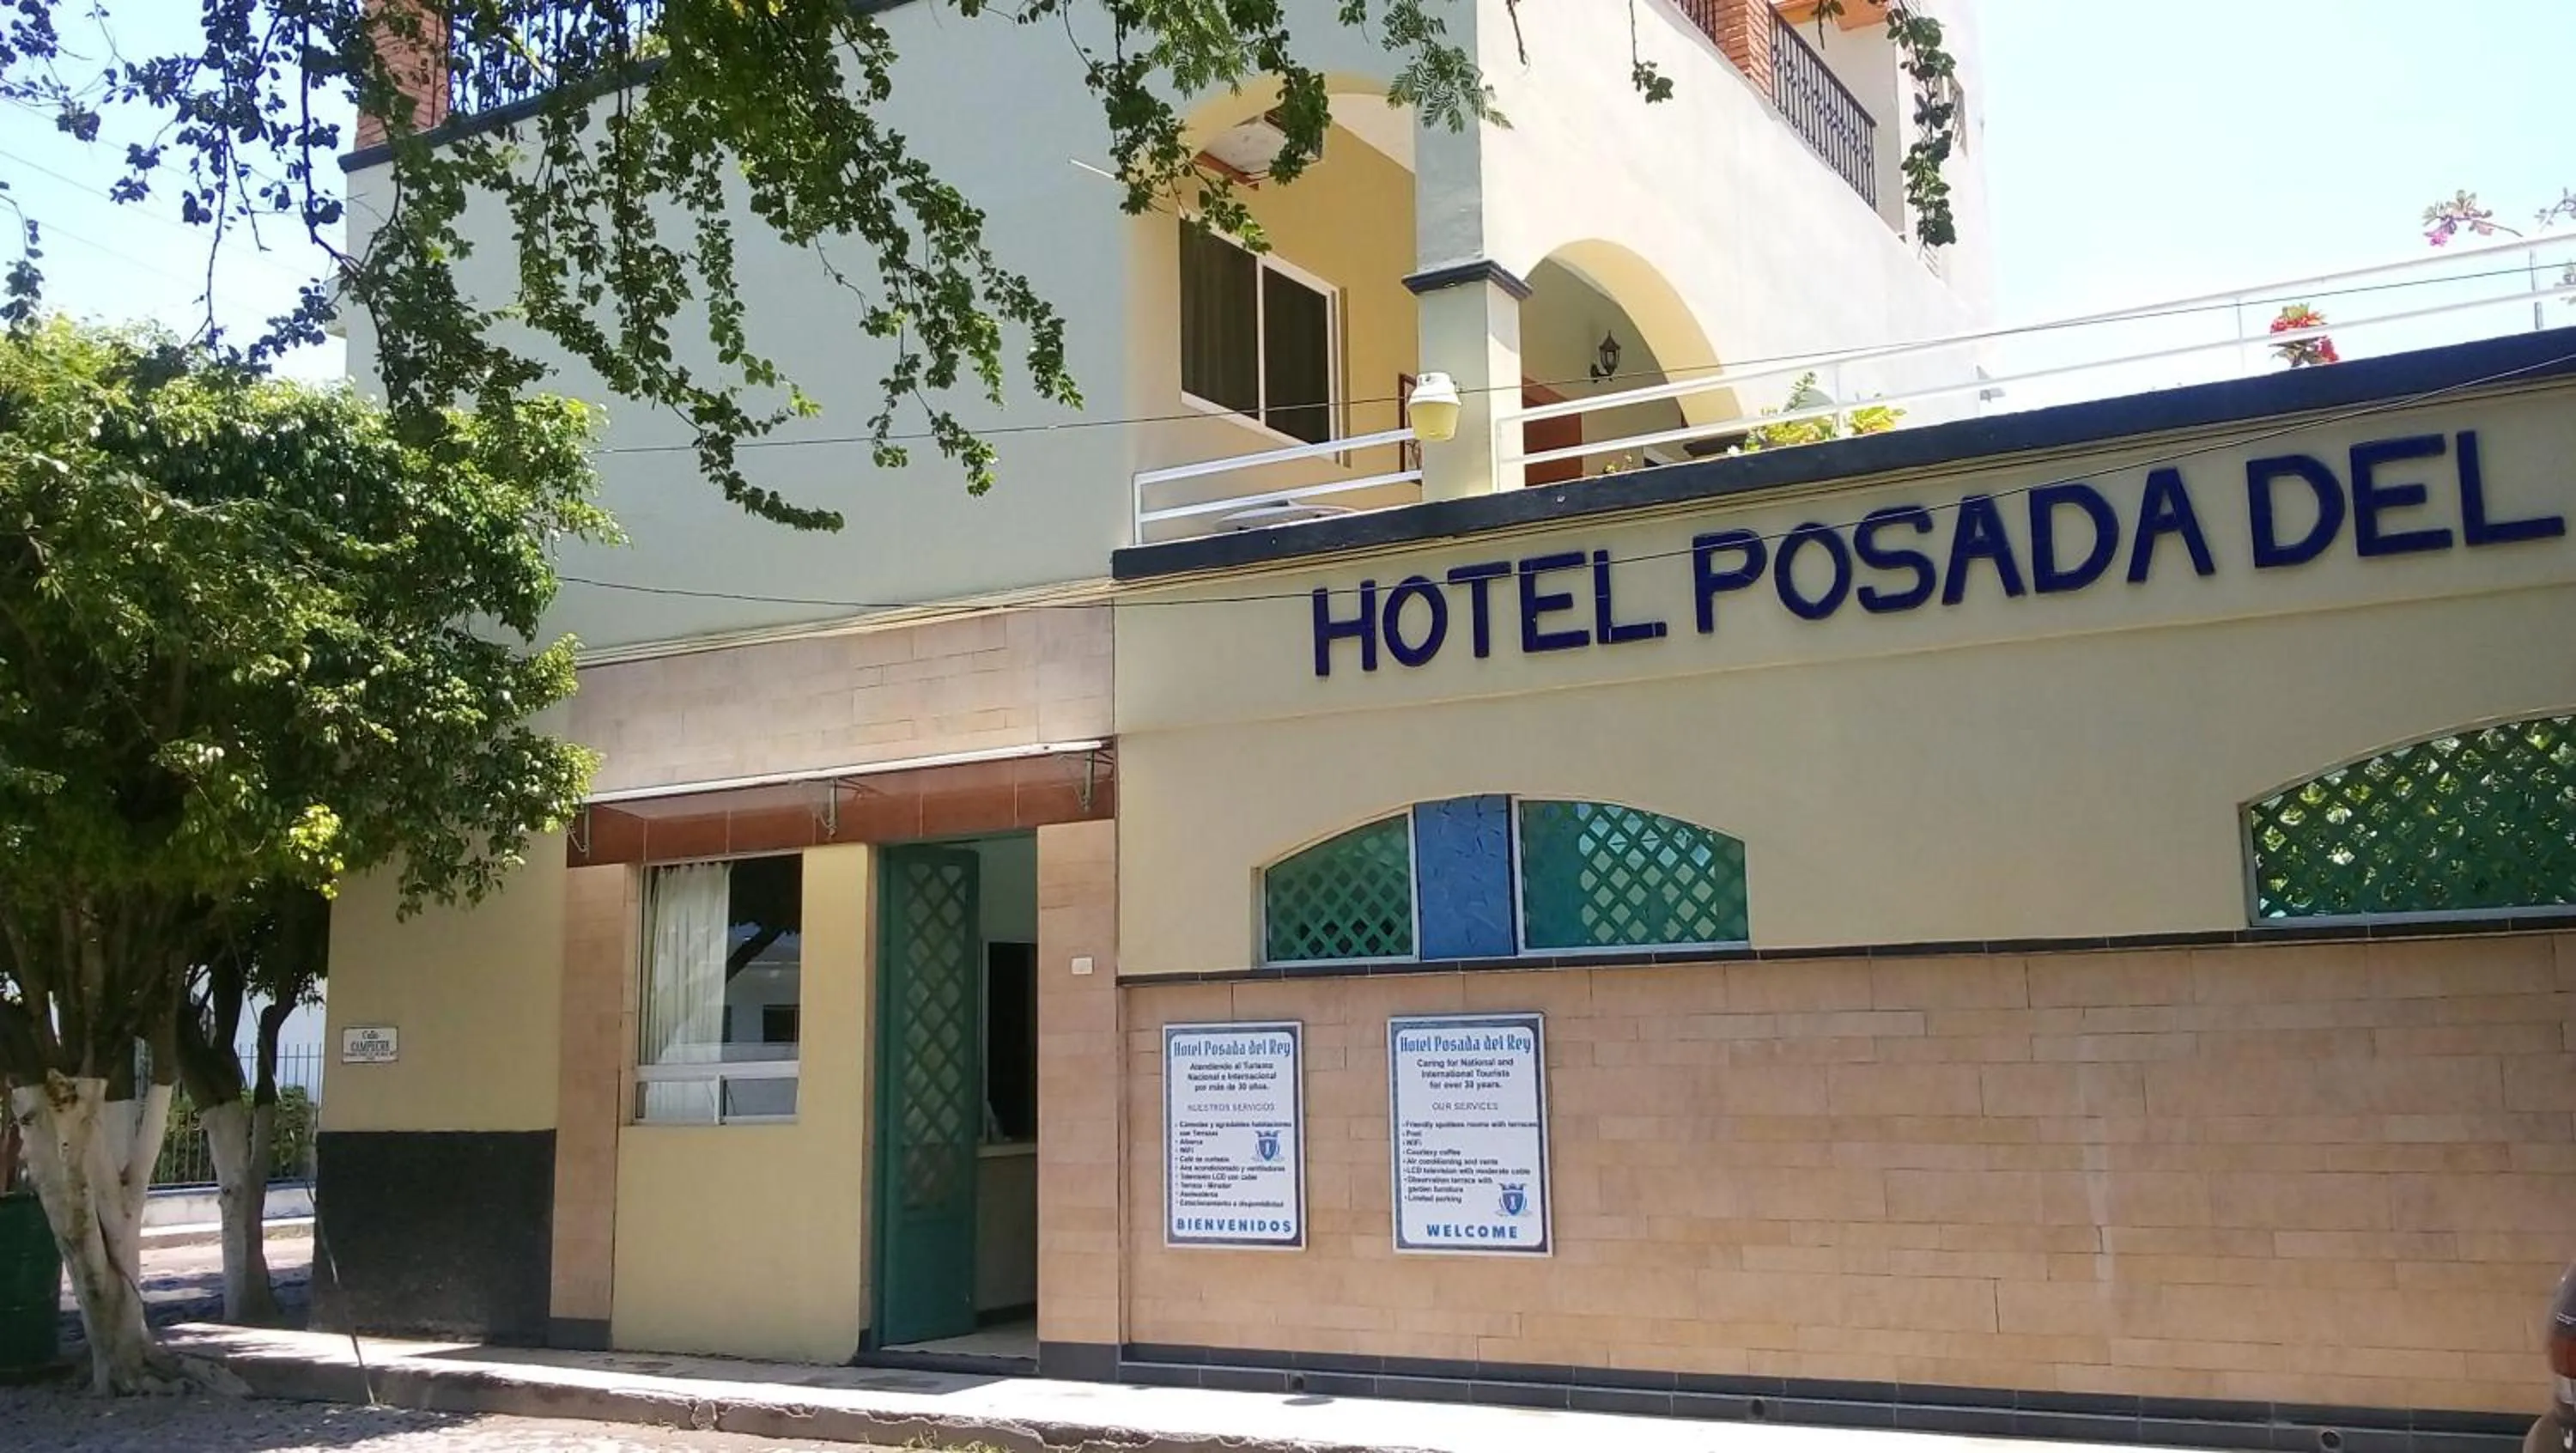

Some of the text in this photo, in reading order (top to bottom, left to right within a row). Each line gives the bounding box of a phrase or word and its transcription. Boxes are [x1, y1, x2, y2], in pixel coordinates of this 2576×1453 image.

[1312, 430, 2566, 676] HOTEL POSADA DEL
[1174, 1038, 1291, 1058] Hotel Posada del Rey
[1400, 1034, 1531, 1054] Hotel Posada del Rey
[1417, 1058, 1444, 1068] Caring
[1461, 1057, 1495, 1066] National
[1498, 1057, 1514, 1066] and
[1421, 1069, 1510, 1078] International Tourists
[1194, 1084, 1206, 1092] por
[1430, 1080, 1441, 1089] for
[1476, 1081, 1502, 1091] years.
[1232, 1103, 1275, 1111] SERVICIOS
[1431, 1102, 1498, 1110] OUR SERVICES
[1177, 1218, 1291, 1232] BIENVENIDOS
[1426, 1224, 1517, 1238] WELCOME
